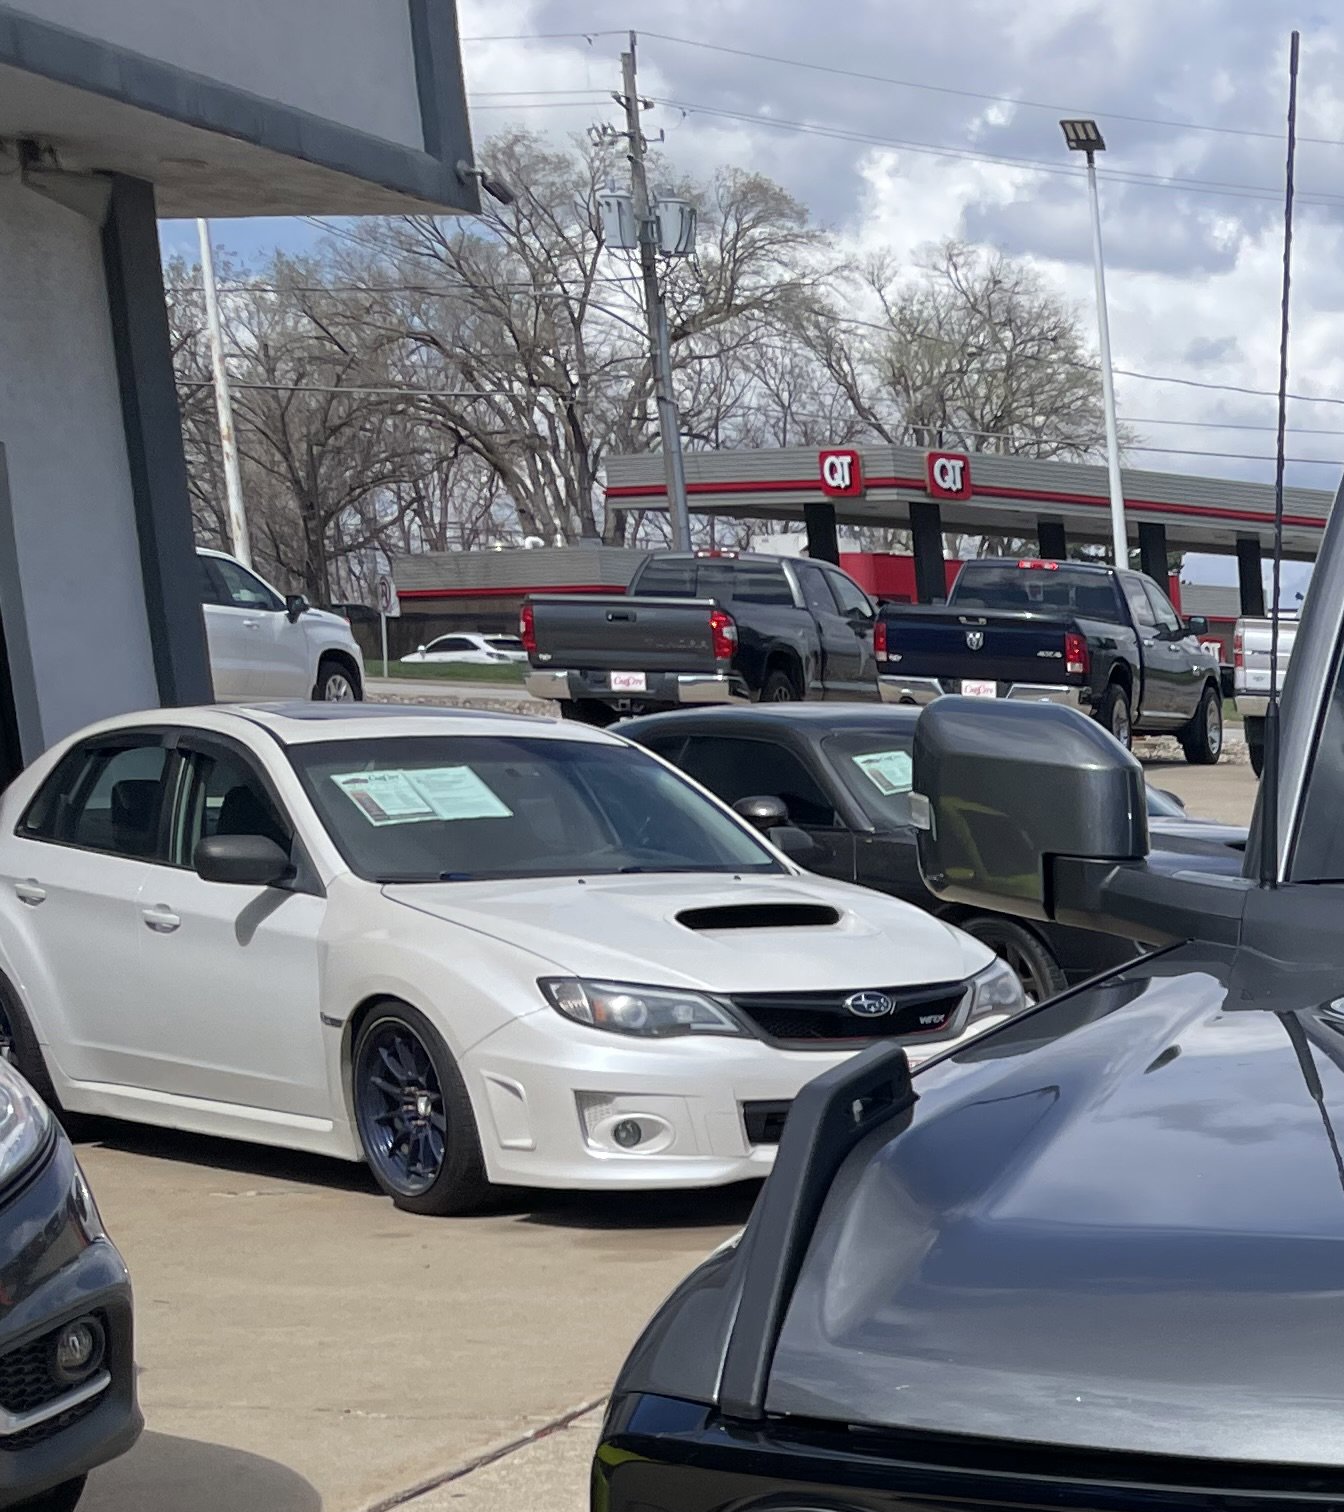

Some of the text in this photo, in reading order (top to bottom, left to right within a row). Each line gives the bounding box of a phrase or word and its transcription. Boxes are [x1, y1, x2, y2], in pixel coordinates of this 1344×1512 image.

[823, 455, 852, 488] QT
[933, 457, 964, 491] QT
[919, 1014, 945, 1025] WRX
